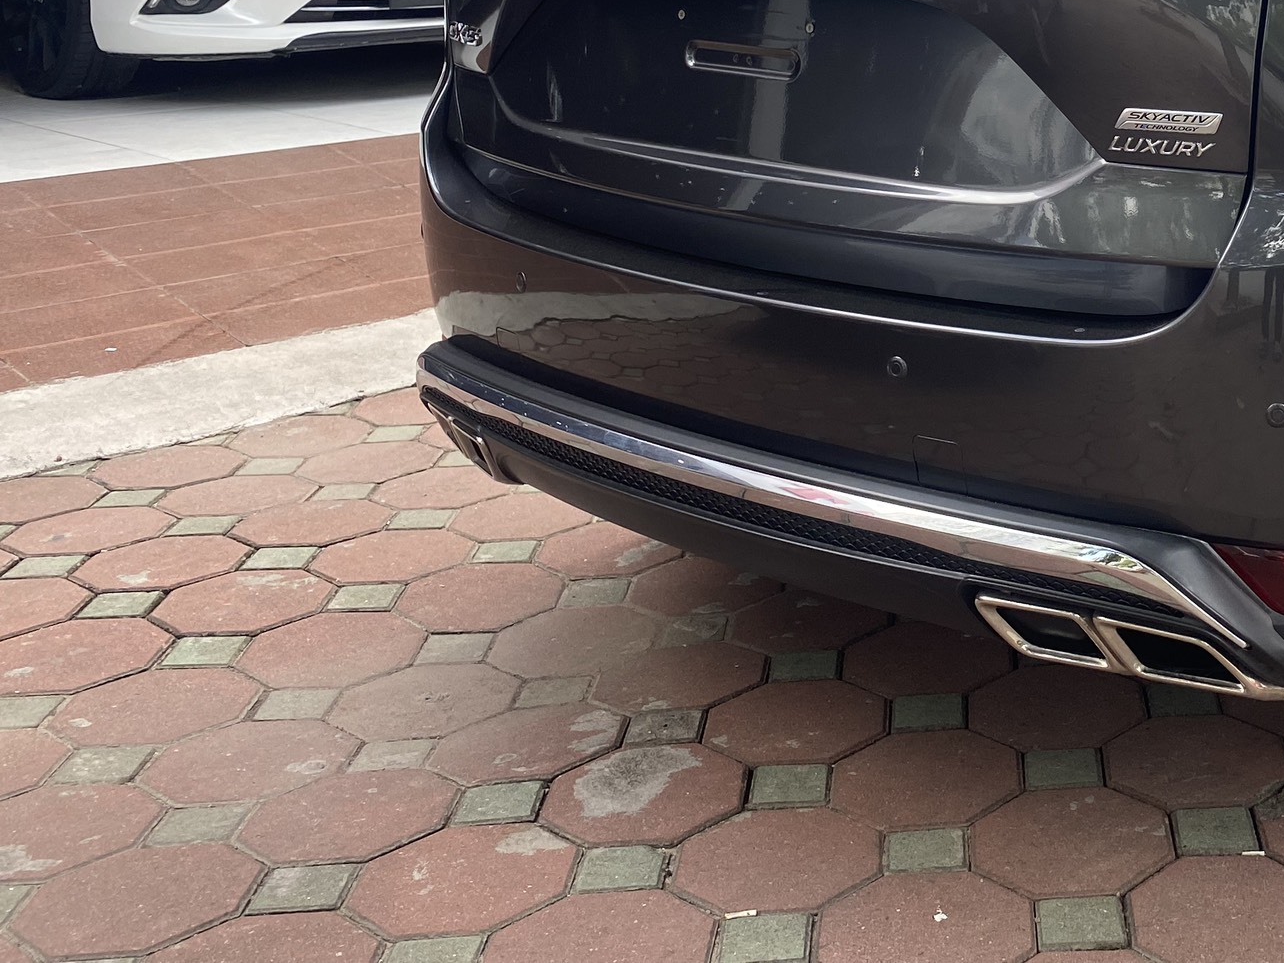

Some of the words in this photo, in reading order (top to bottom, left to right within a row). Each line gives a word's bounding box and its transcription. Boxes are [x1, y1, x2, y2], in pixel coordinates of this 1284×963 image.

[1127, 111, 1211, 124] SKYACTIV
[1134, 123, 1199, 133] TECHNOLOGY
[1108, 135, 1216, 158] LUXURY
